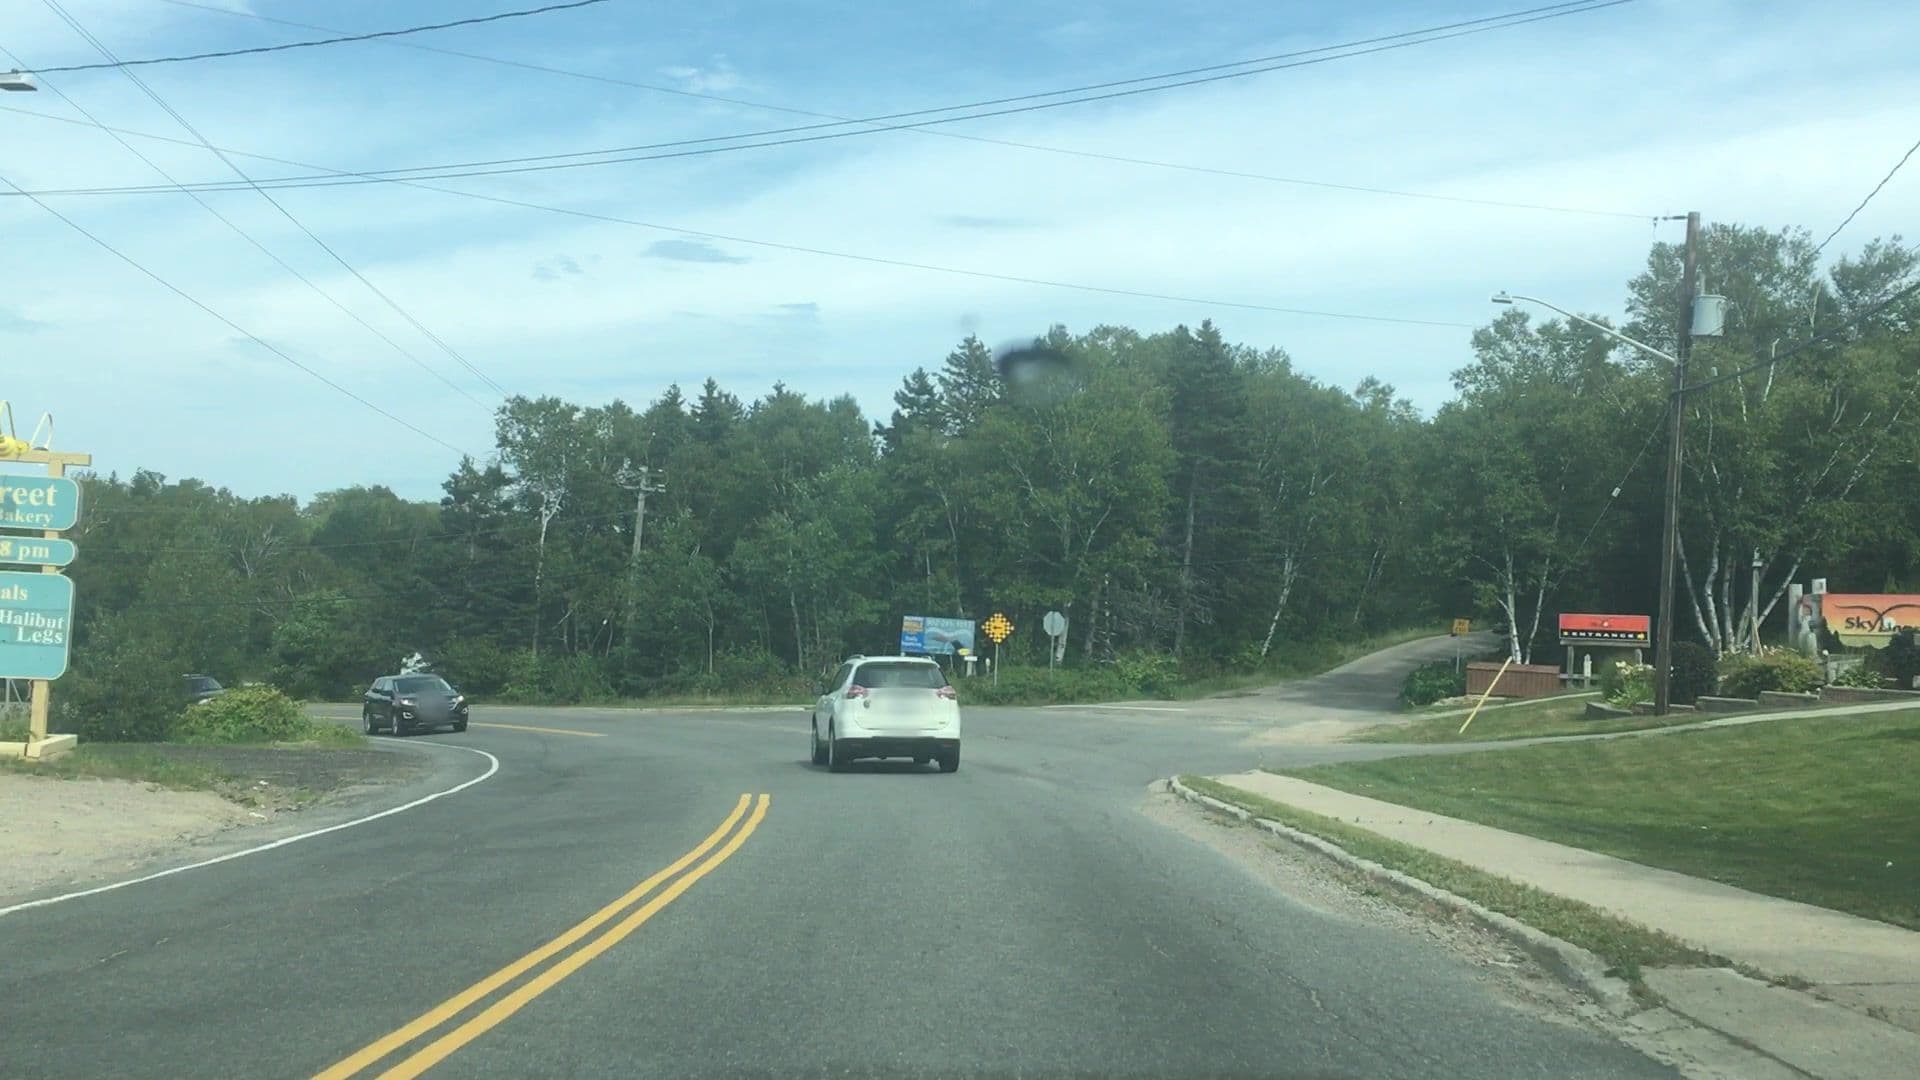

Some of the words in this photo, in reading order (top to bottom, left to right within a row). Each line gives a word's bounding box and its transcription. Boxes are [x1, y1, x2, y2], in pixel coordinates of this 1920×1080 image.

[18, 546, 49, 560] pm
[0, 610, 64, 628] Halibut
[16, 626, 63, 644] Legs
